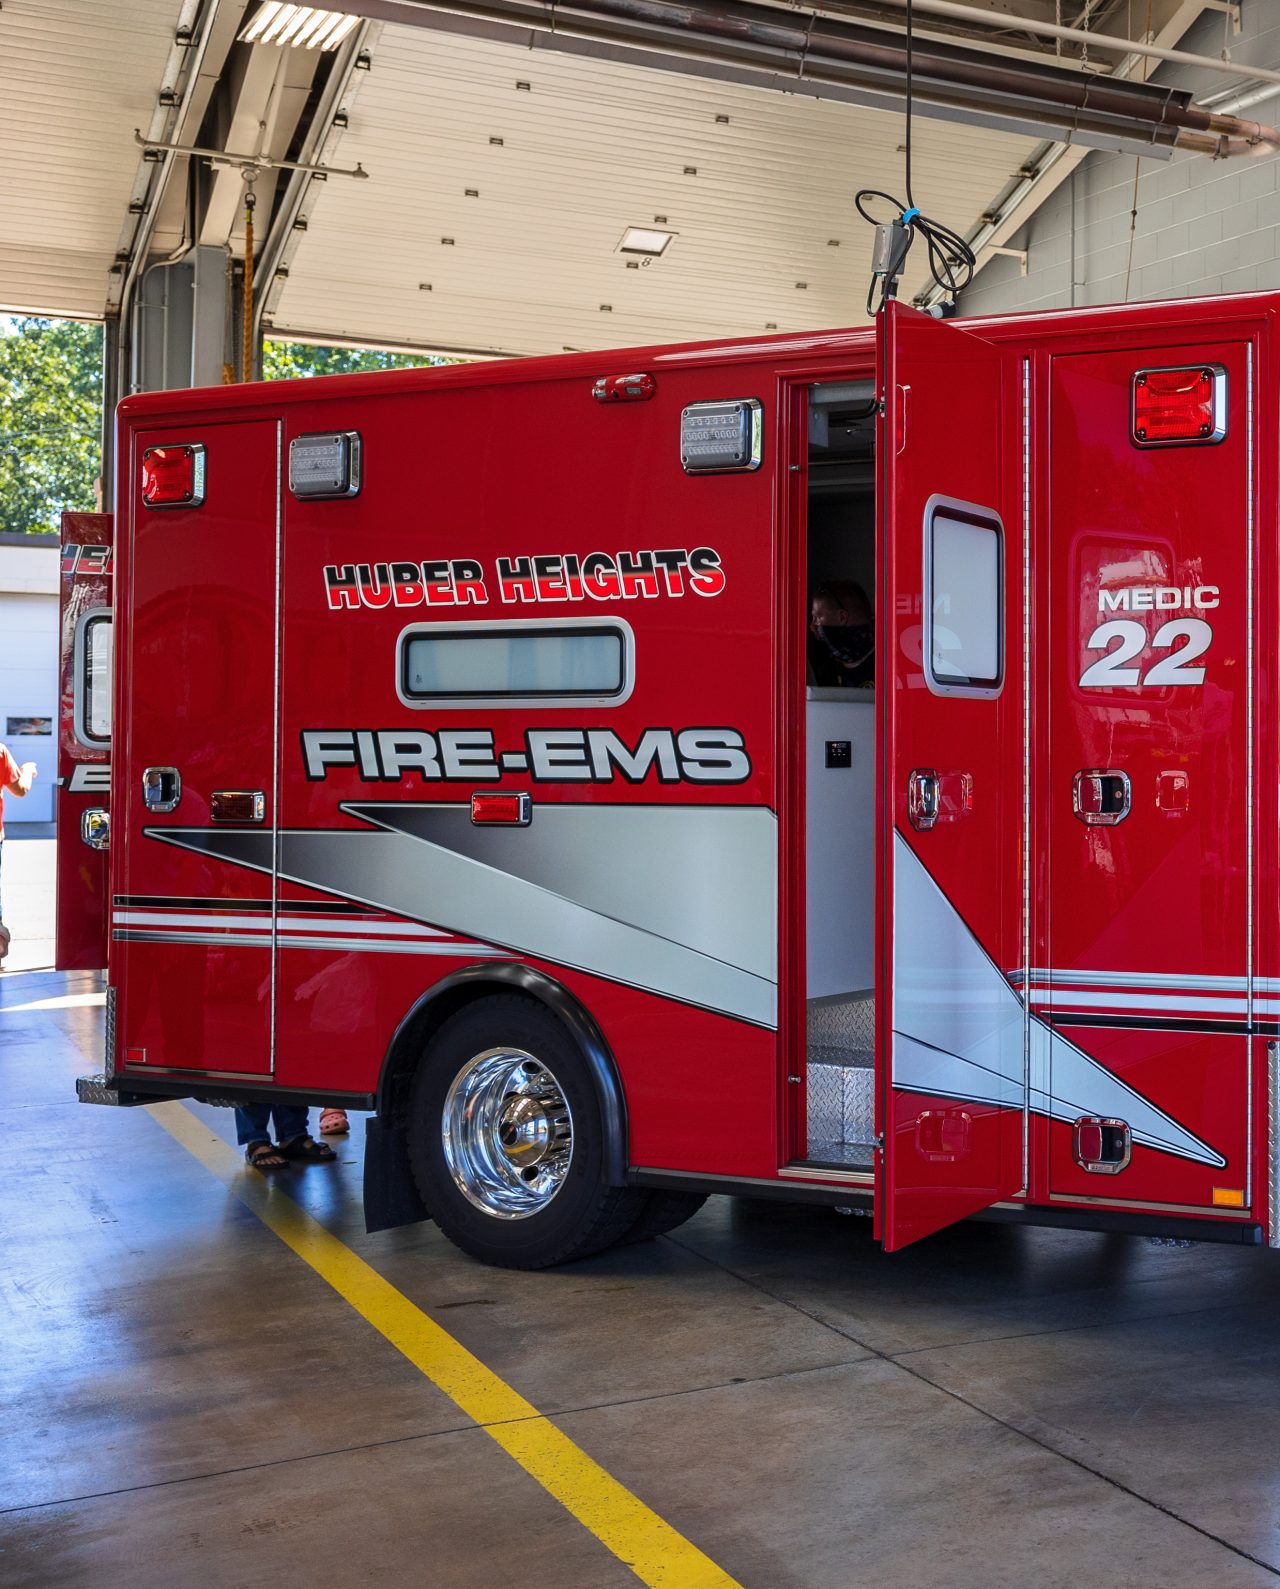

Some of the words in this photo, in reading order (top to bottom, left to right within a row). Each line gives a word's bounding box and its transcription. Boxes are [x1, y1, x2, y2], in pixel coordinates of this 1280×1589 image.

[323, 559, 488, 610] HUBER
[496, 547, 726, 604] HEIGHTS
[1098, 585, 1220, 611] MEDIC
[1078, 617, 1213, 688] 22
[300, 727, 752, 785] FIRE-EMS
